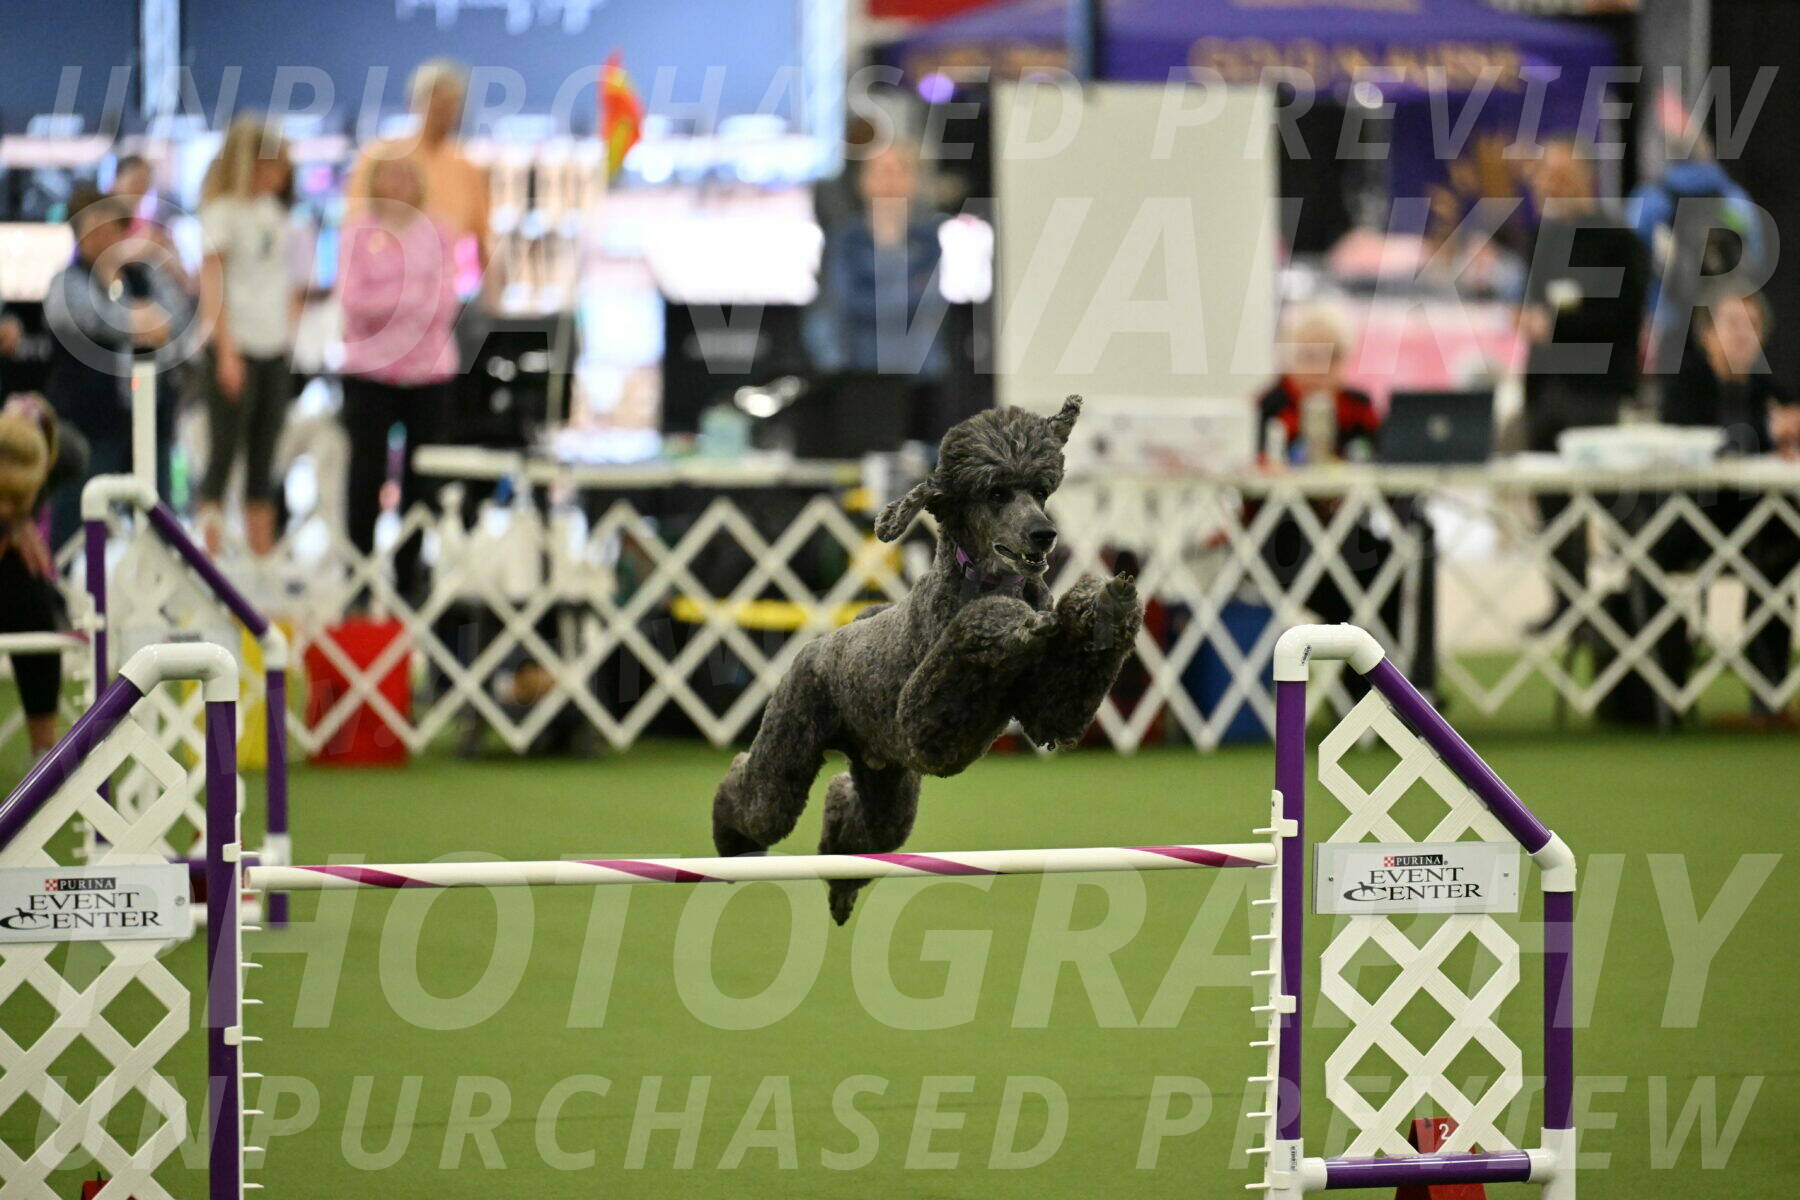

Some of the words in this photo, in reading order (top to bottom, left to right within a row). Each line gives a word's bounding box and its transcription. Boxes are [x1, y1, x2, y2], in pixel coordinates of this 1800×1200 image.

[59, 878, 114, 890] PURINA
[1369, 867, 1464, 885] EVENT
[29, 892, 140, 911] EVENT
[1343, 883, 1483, 902] CENTER
[0, 911, 162, 931] CENTER
